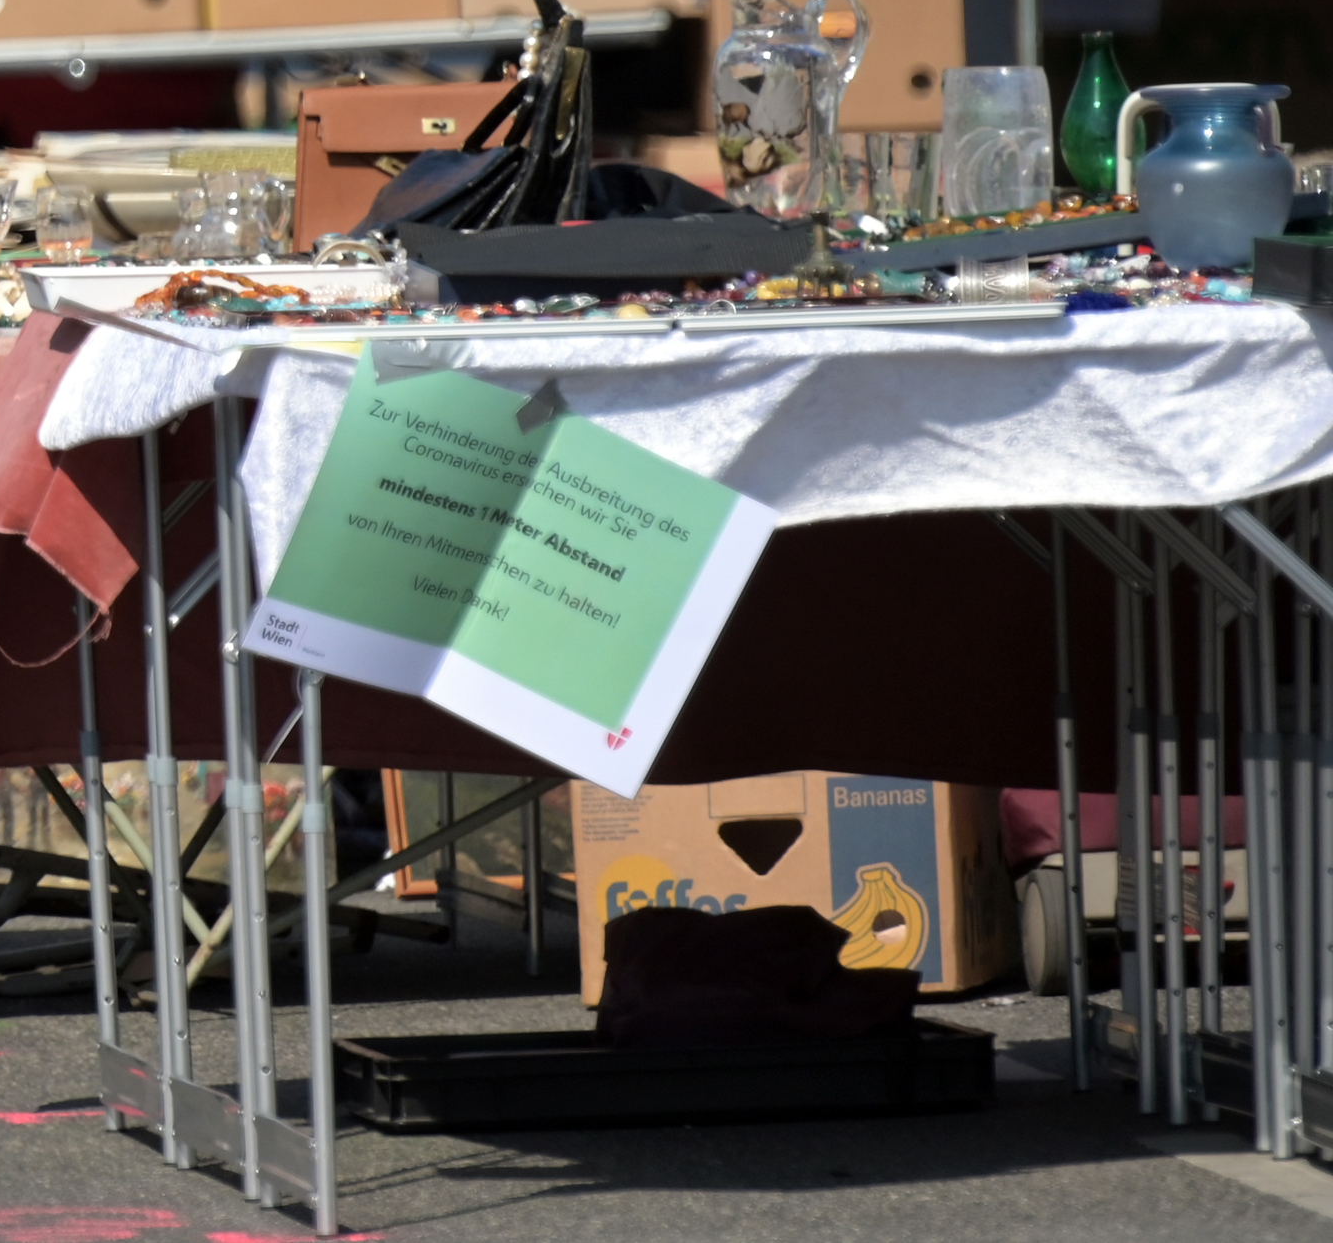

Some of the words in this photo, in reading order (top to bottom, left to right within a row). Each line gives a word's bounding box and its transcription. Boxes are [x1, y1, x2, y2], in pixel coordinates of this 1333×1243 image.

[369, 399, 401, 424] Zur
[406, 411, 517, 466] Verhinderung
[546, 461, 656, 529] Ausbreitung
[658, 518, 691, 542] des
[404, 436, 500, 480] Coronavirus
[580, 504, 609, 525] wir
[610, 516, 638, 541] Sie
[379, 477, 477, 518] mindestens
[481, 506, 491, 521] 1
[489, 508, 543, 540] Meter
[544, 533, 627, 583] Abstand
[348, 514, 379, 533] von
[381, 520, 423, 547] Ihren
[425, 534, 531, 585] Mitmenschen
[533, 578, 556, 596] zu
[558, 586, 622, 629] halten!
[413, 575, 458, 601] Vielen
[461, 588, 510, 622] Dank!
[261, 627, 293, 648] Wien
[266, 614, 300, 634] Stadt
[833, 786, 928, 808] Bananas
